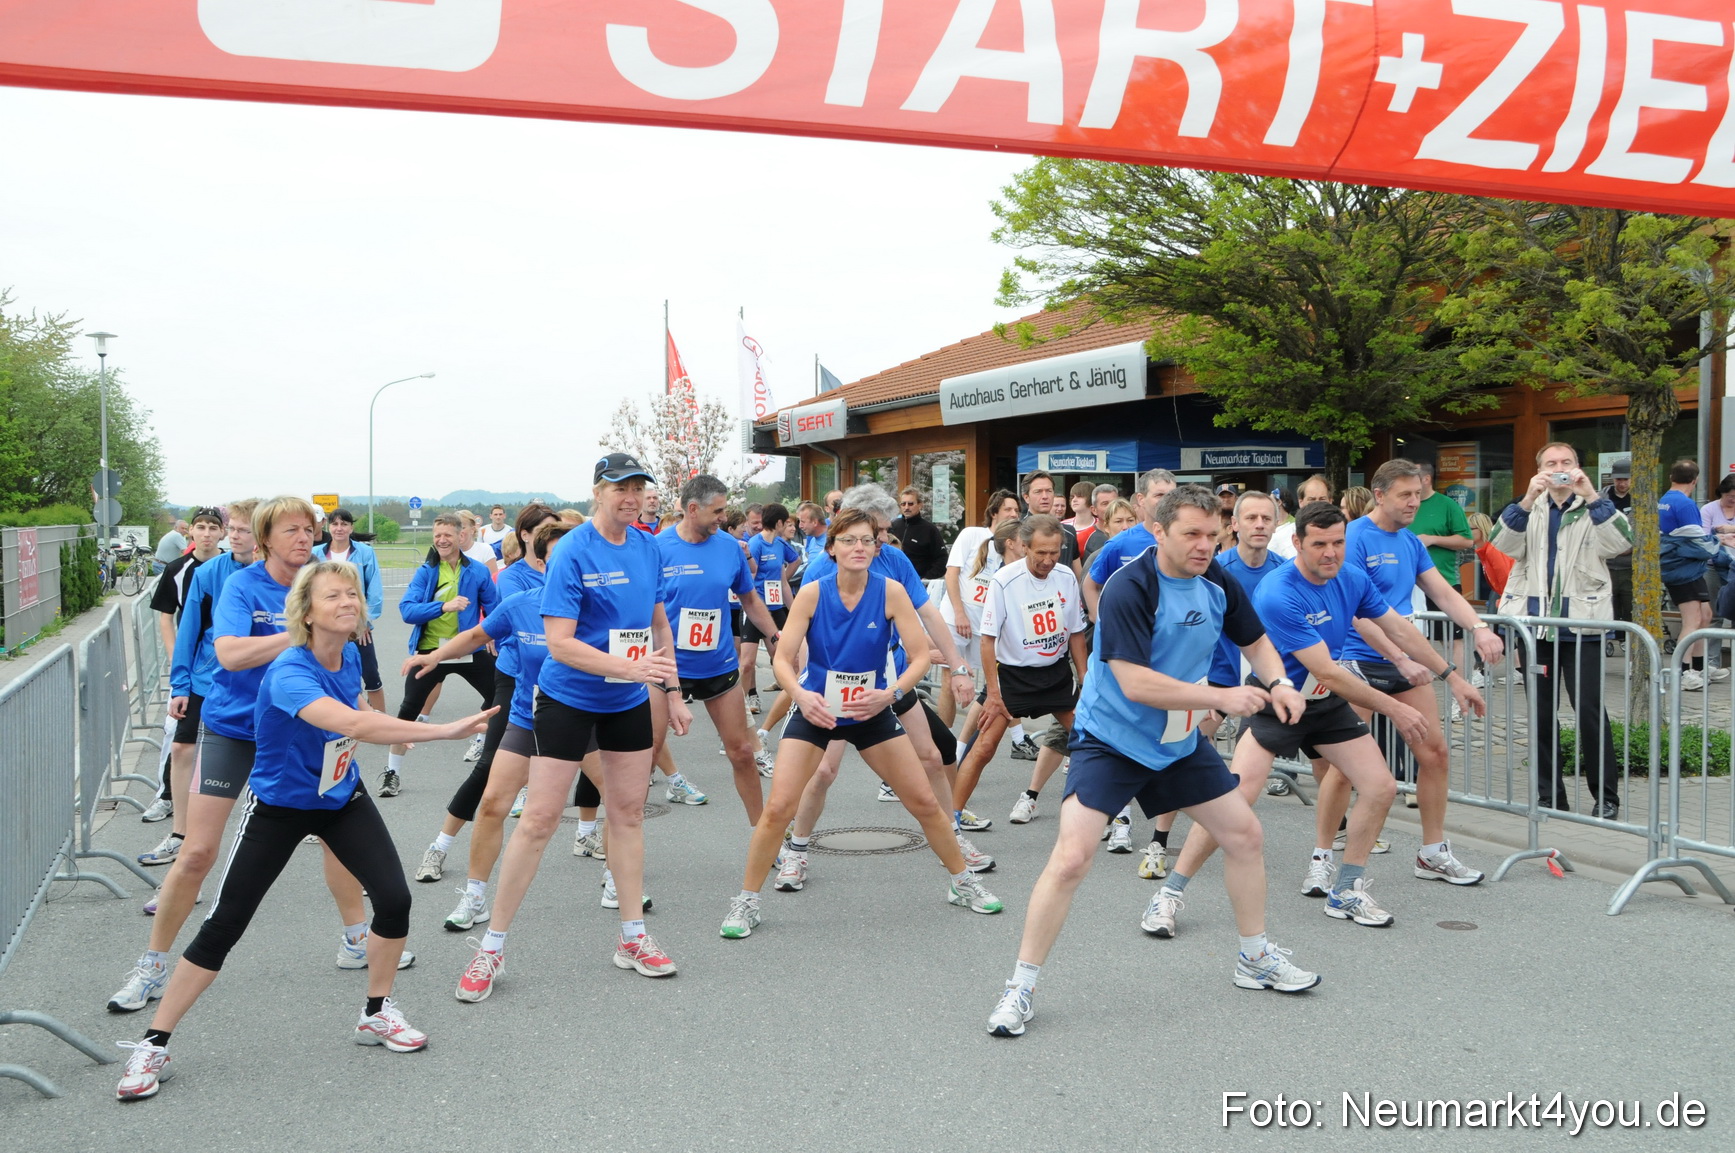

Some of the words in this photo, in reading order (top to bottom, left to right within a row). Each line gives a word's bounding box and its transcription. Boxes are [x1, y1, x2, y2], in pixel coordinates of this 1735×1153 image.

[950, 388, 1005, 410] Autohaus
[1010, 376, 1064, 399] Gerhart
[1069, 371, 1081, 390] &
[1087, 363, 1127, 389] Jänig
[797, 411, 835, 432] SEAT
[1205, 453, 1250, 465] Neumarkter
[1251, 452, 1283, 465] Tagblatt
[769, 589, 780, 603] 56
[1028, 601, 1046, 609] MEYER
[1032, 610, 1057, 636] 86
[620, 631, 644, 639] MEYER
[689, 623, 713, 647] 64
[204, 778, 231, 789] ODLO
